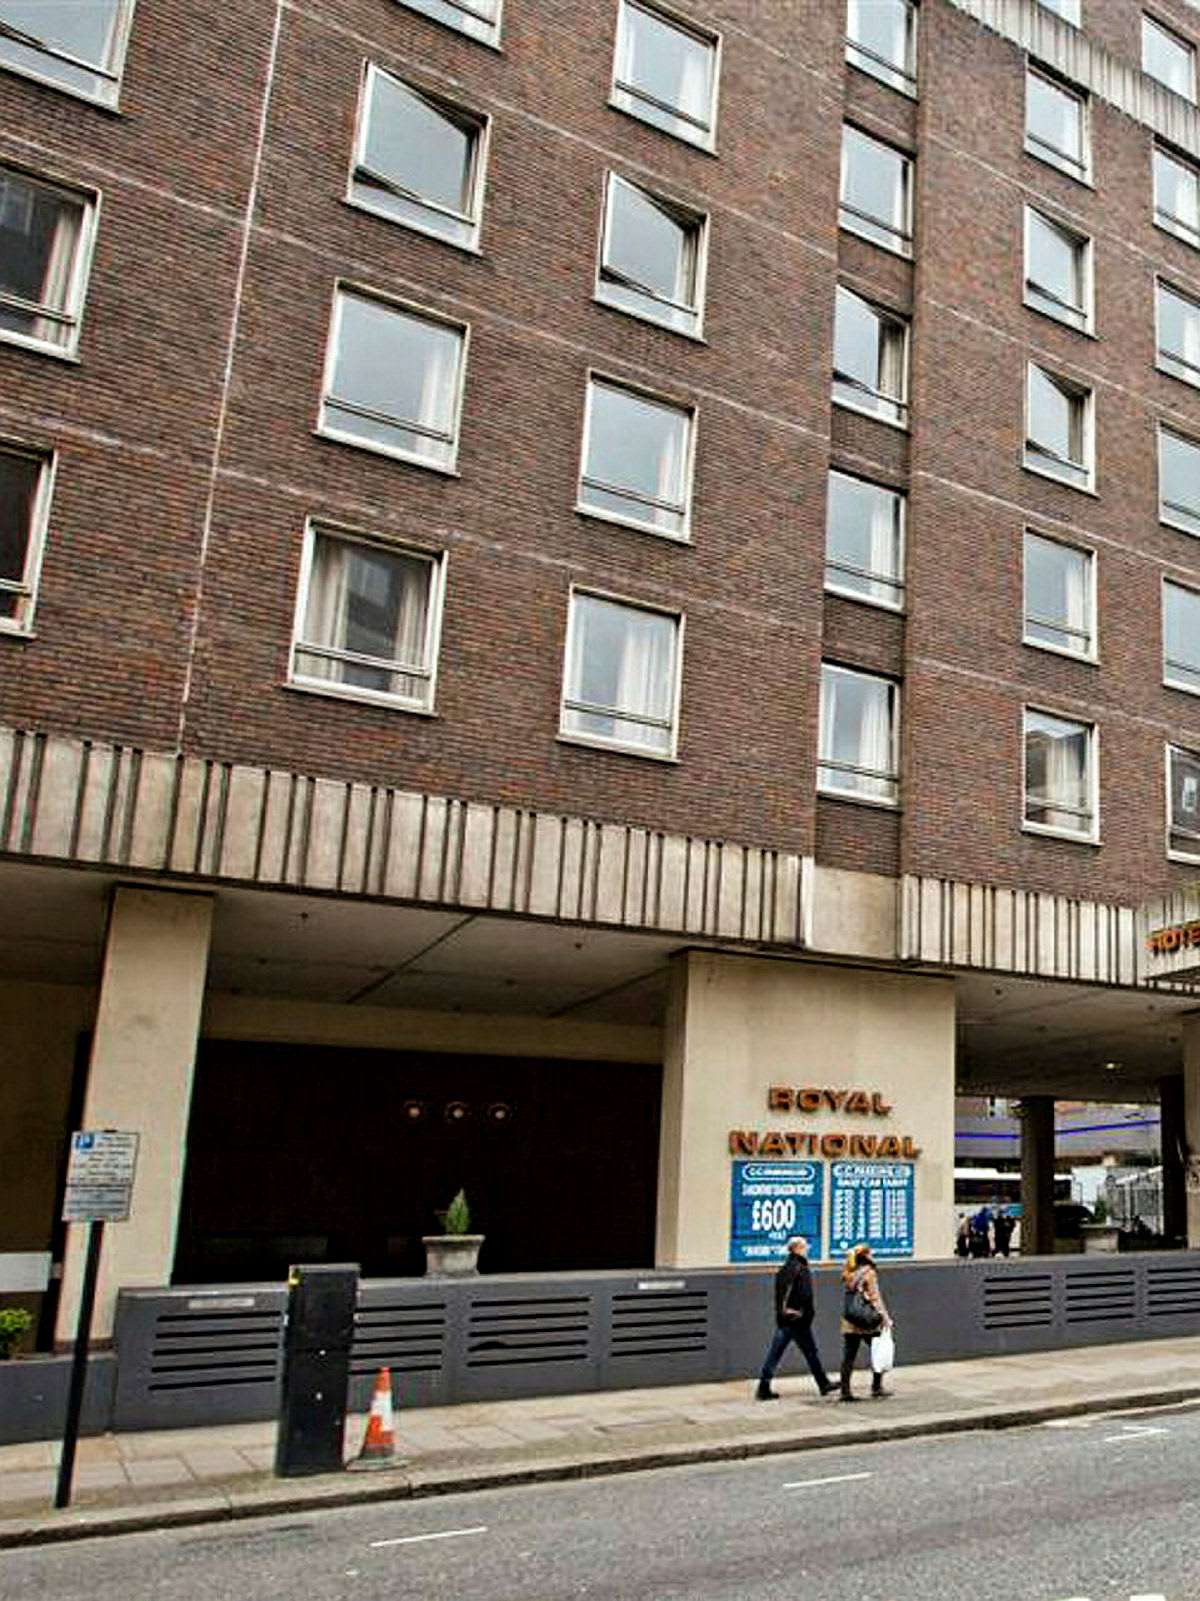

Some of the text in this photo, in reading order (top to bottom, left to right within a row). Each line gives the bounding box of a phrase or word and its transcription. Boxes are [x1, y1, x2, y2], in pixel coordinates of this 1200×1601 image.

[768, 1086, 892, 1116] ROYAL
[727, 1130, 922, 1158] NATIONAL
[751, 1199, 796, 1231] £600
